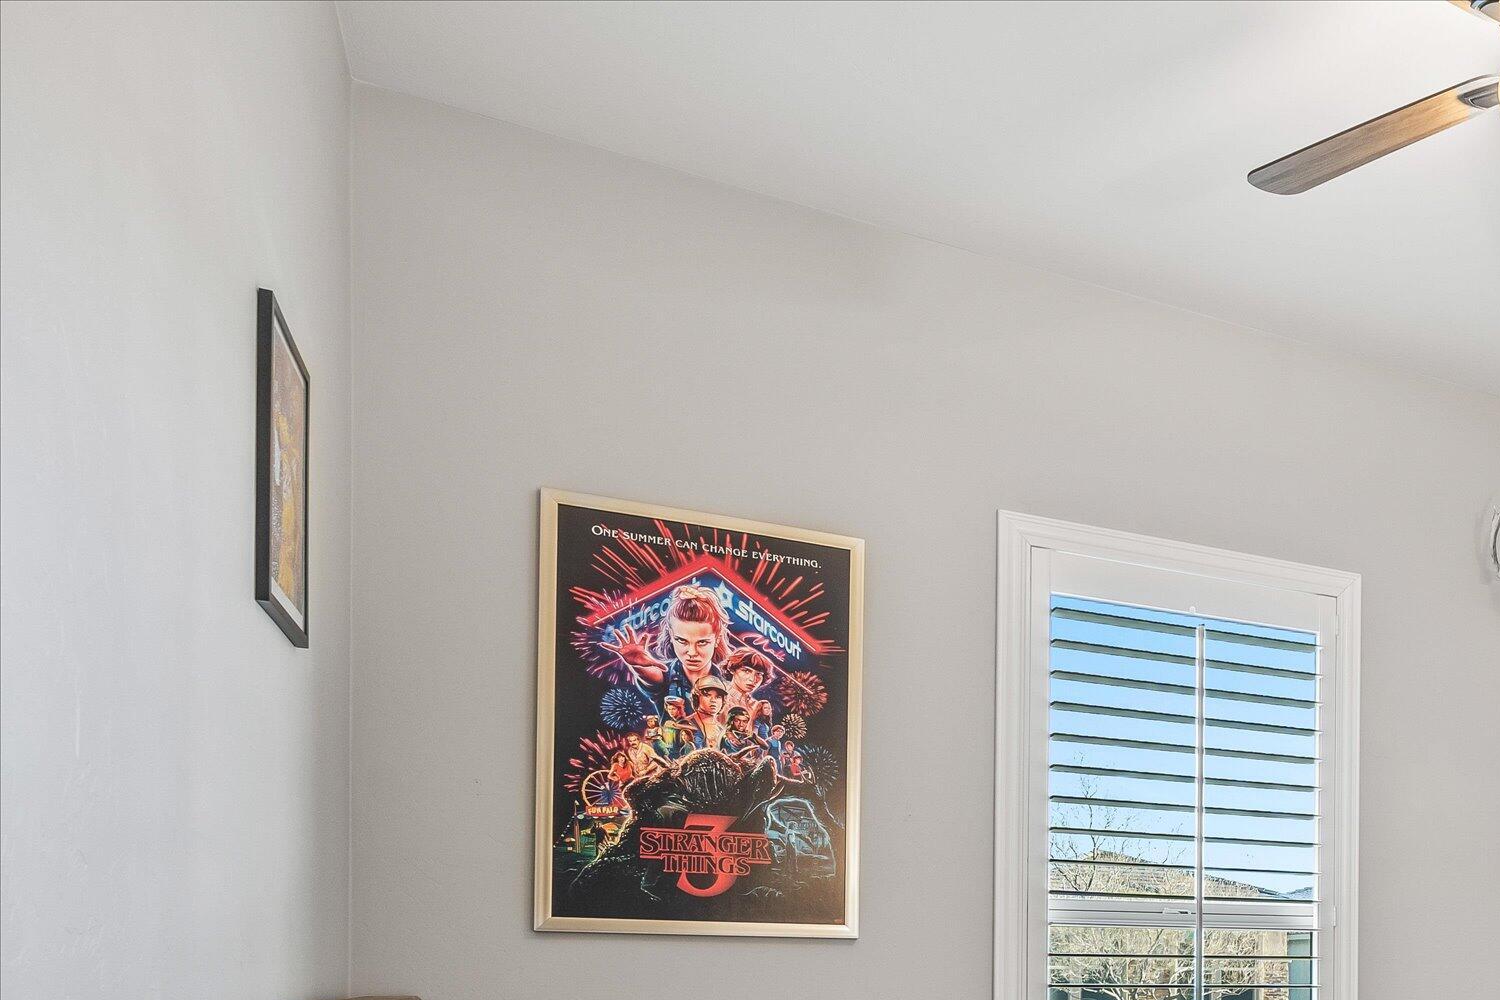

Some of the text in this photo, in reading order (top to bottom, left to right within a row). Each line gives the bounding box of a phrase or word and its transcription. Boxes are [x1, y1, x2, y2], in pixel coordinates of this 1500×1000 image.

[591, 525, 822, 569] ONE SUMMER CAN CHANGE EVERYTHING.
[735, 600, 802, 660] starcourt
[640, 831, 772, 861] STRANGER
[662, 852, 751, 876] THINGS
